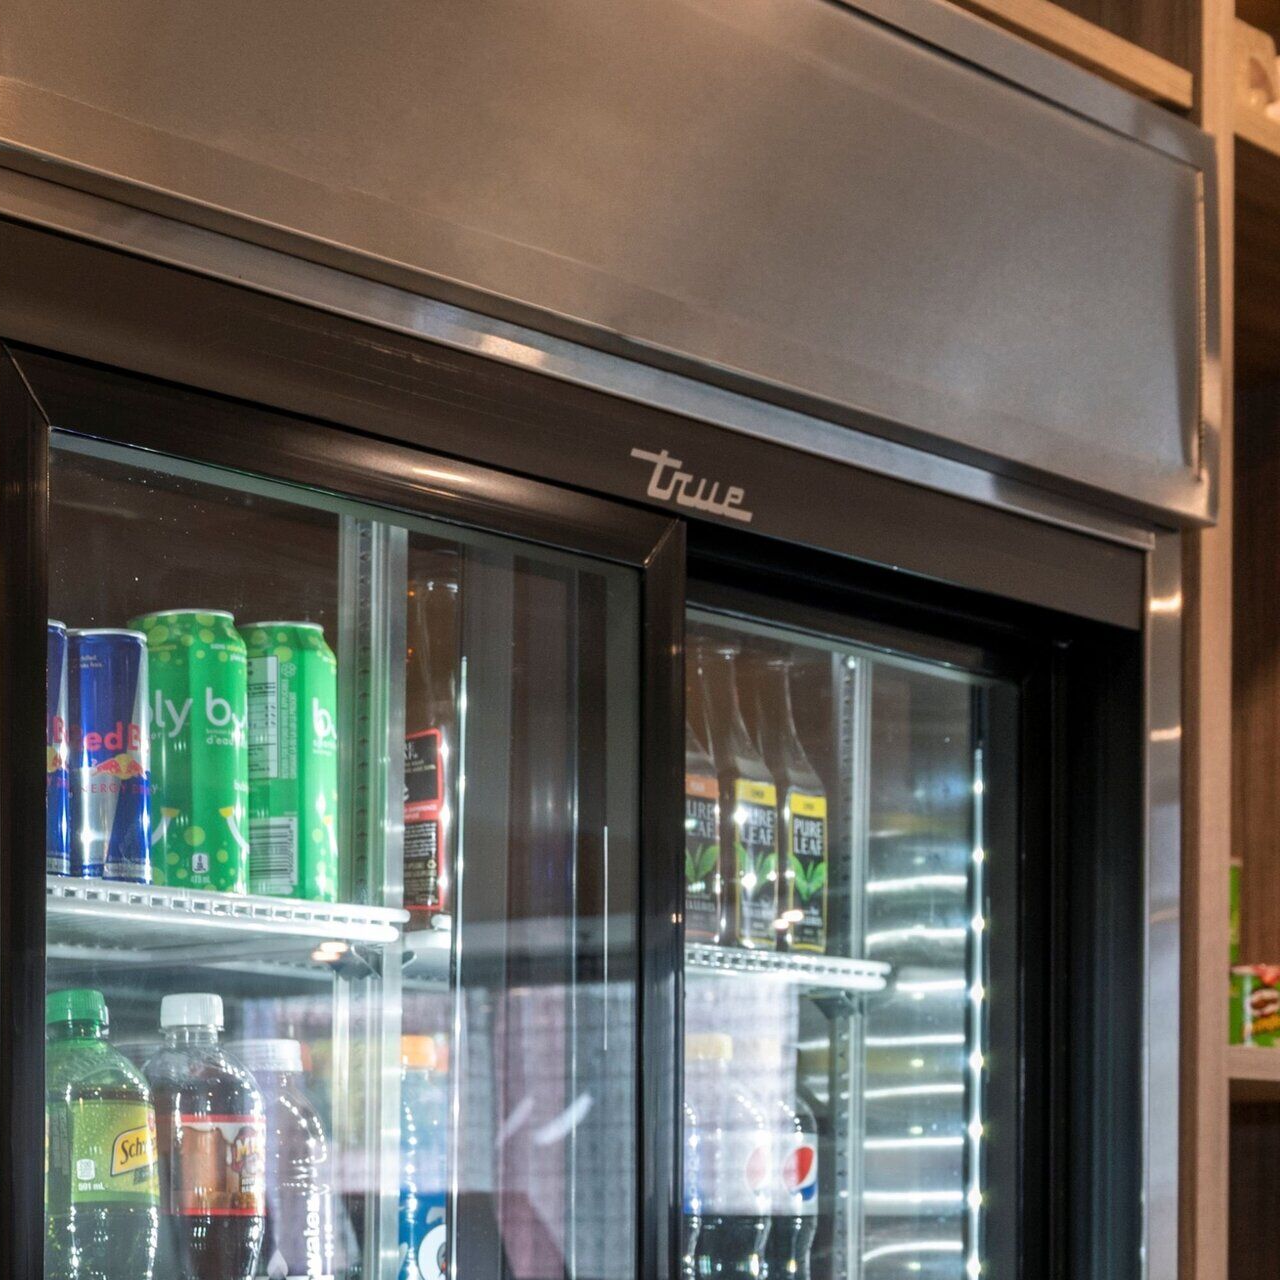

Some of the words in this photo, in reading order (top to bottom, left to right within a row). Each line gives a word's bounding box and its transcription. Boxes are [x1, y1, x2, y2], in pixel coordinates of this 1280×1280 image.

[745, 807, 775, 828] URE
[793, 817, 823, 835] PURE
[794, 836, 824, 857] LEAF
